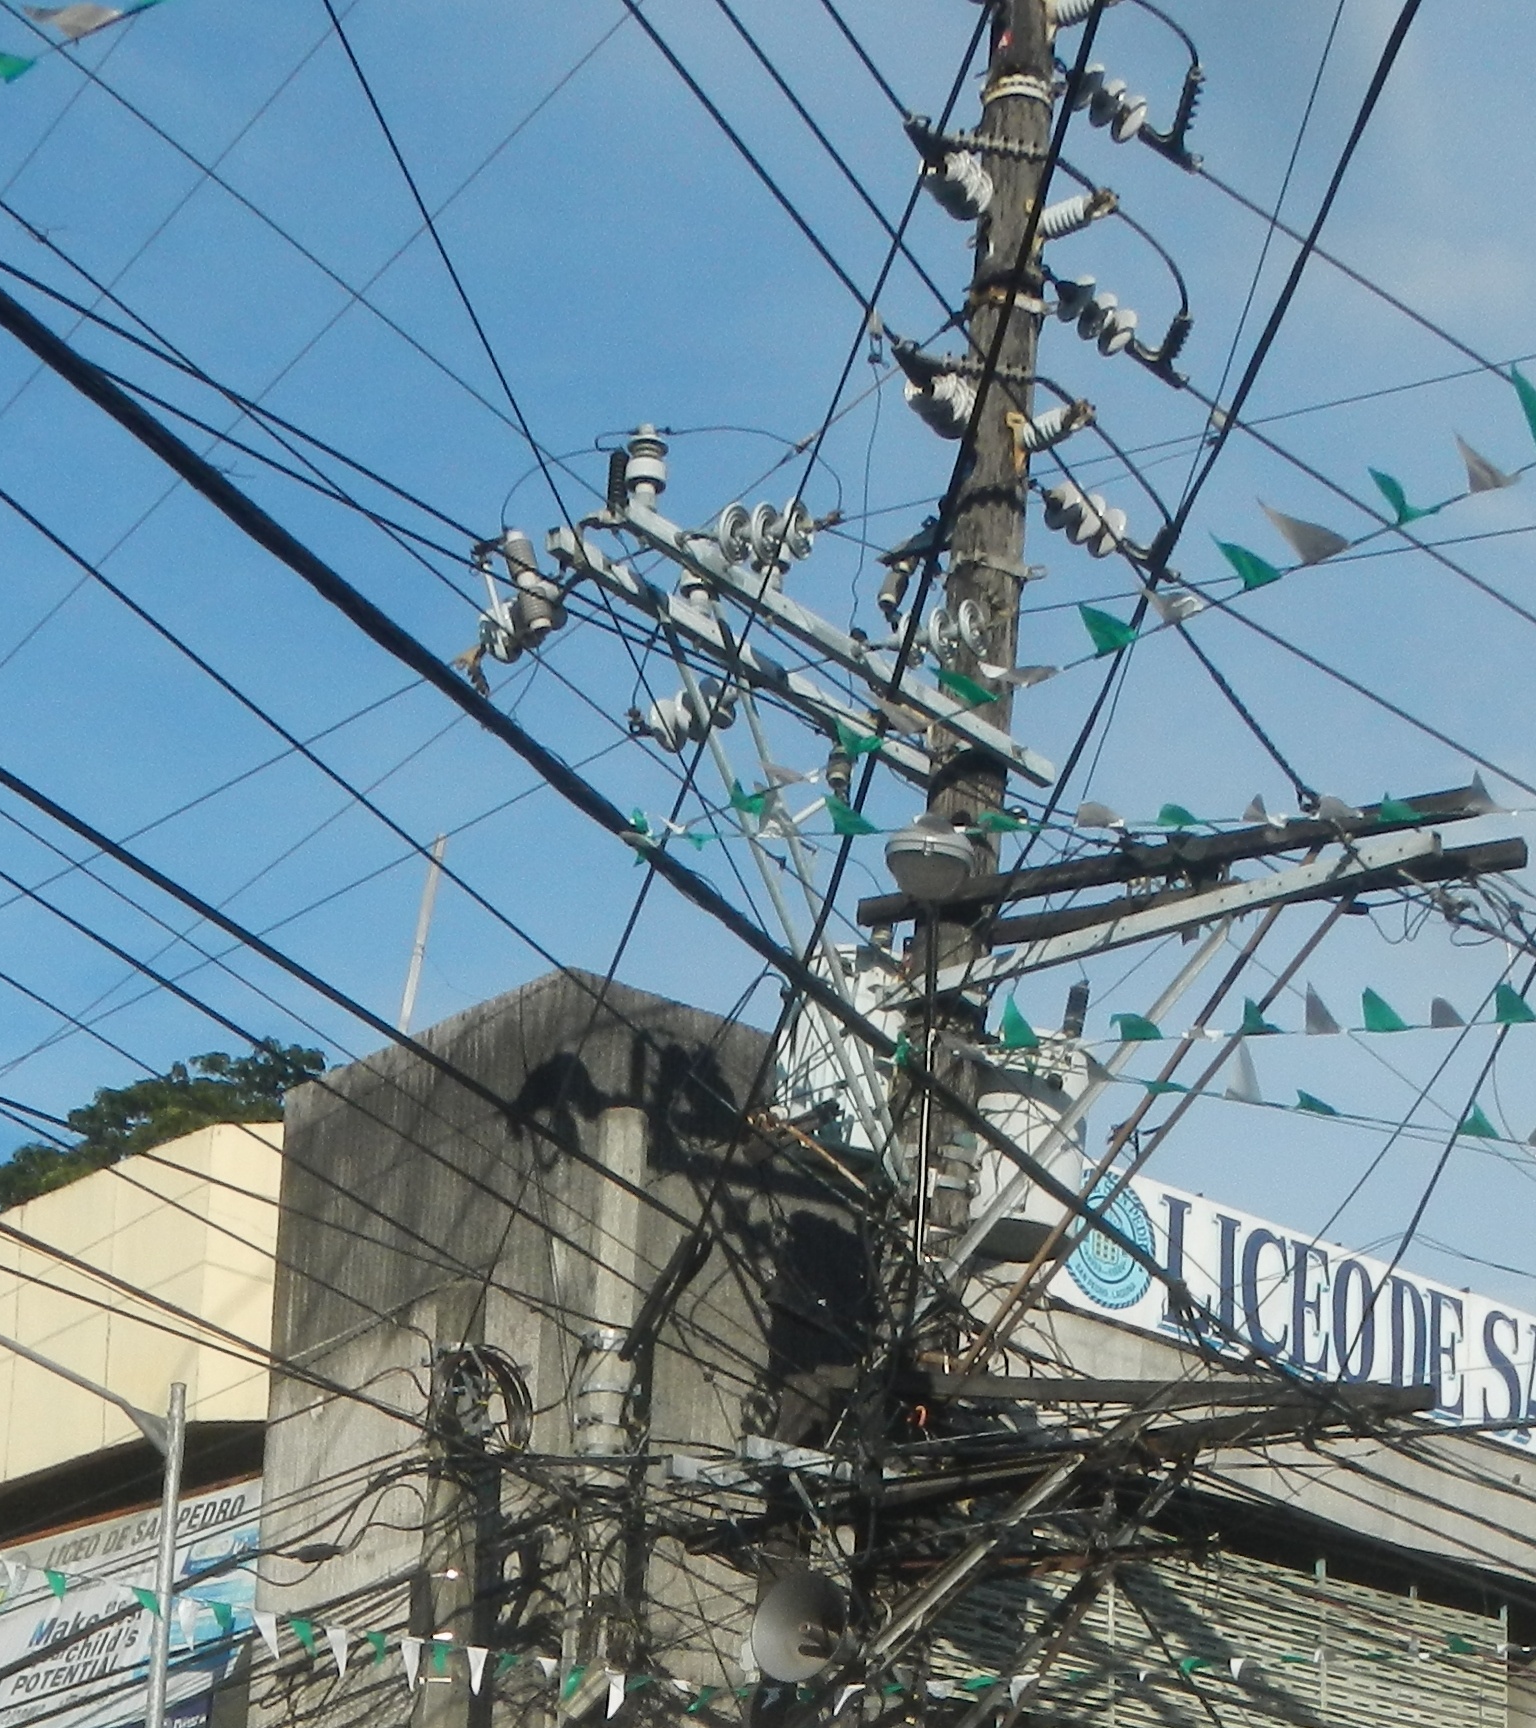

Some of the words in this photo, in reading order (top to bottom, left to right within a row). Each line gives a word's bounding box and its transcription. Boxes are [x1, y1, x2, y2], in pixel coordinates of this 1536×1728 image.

[1155, 1191, 1375, 1386] LICEO
[1378, 1272, 1465, 1416] DE
[43, 1539, 100, 1568] LICEO
[103, 1531, 125, 1553] DE
[175, 1493, 248, 1535] PEDRO
[64, 1628, 140, 1666] child's
